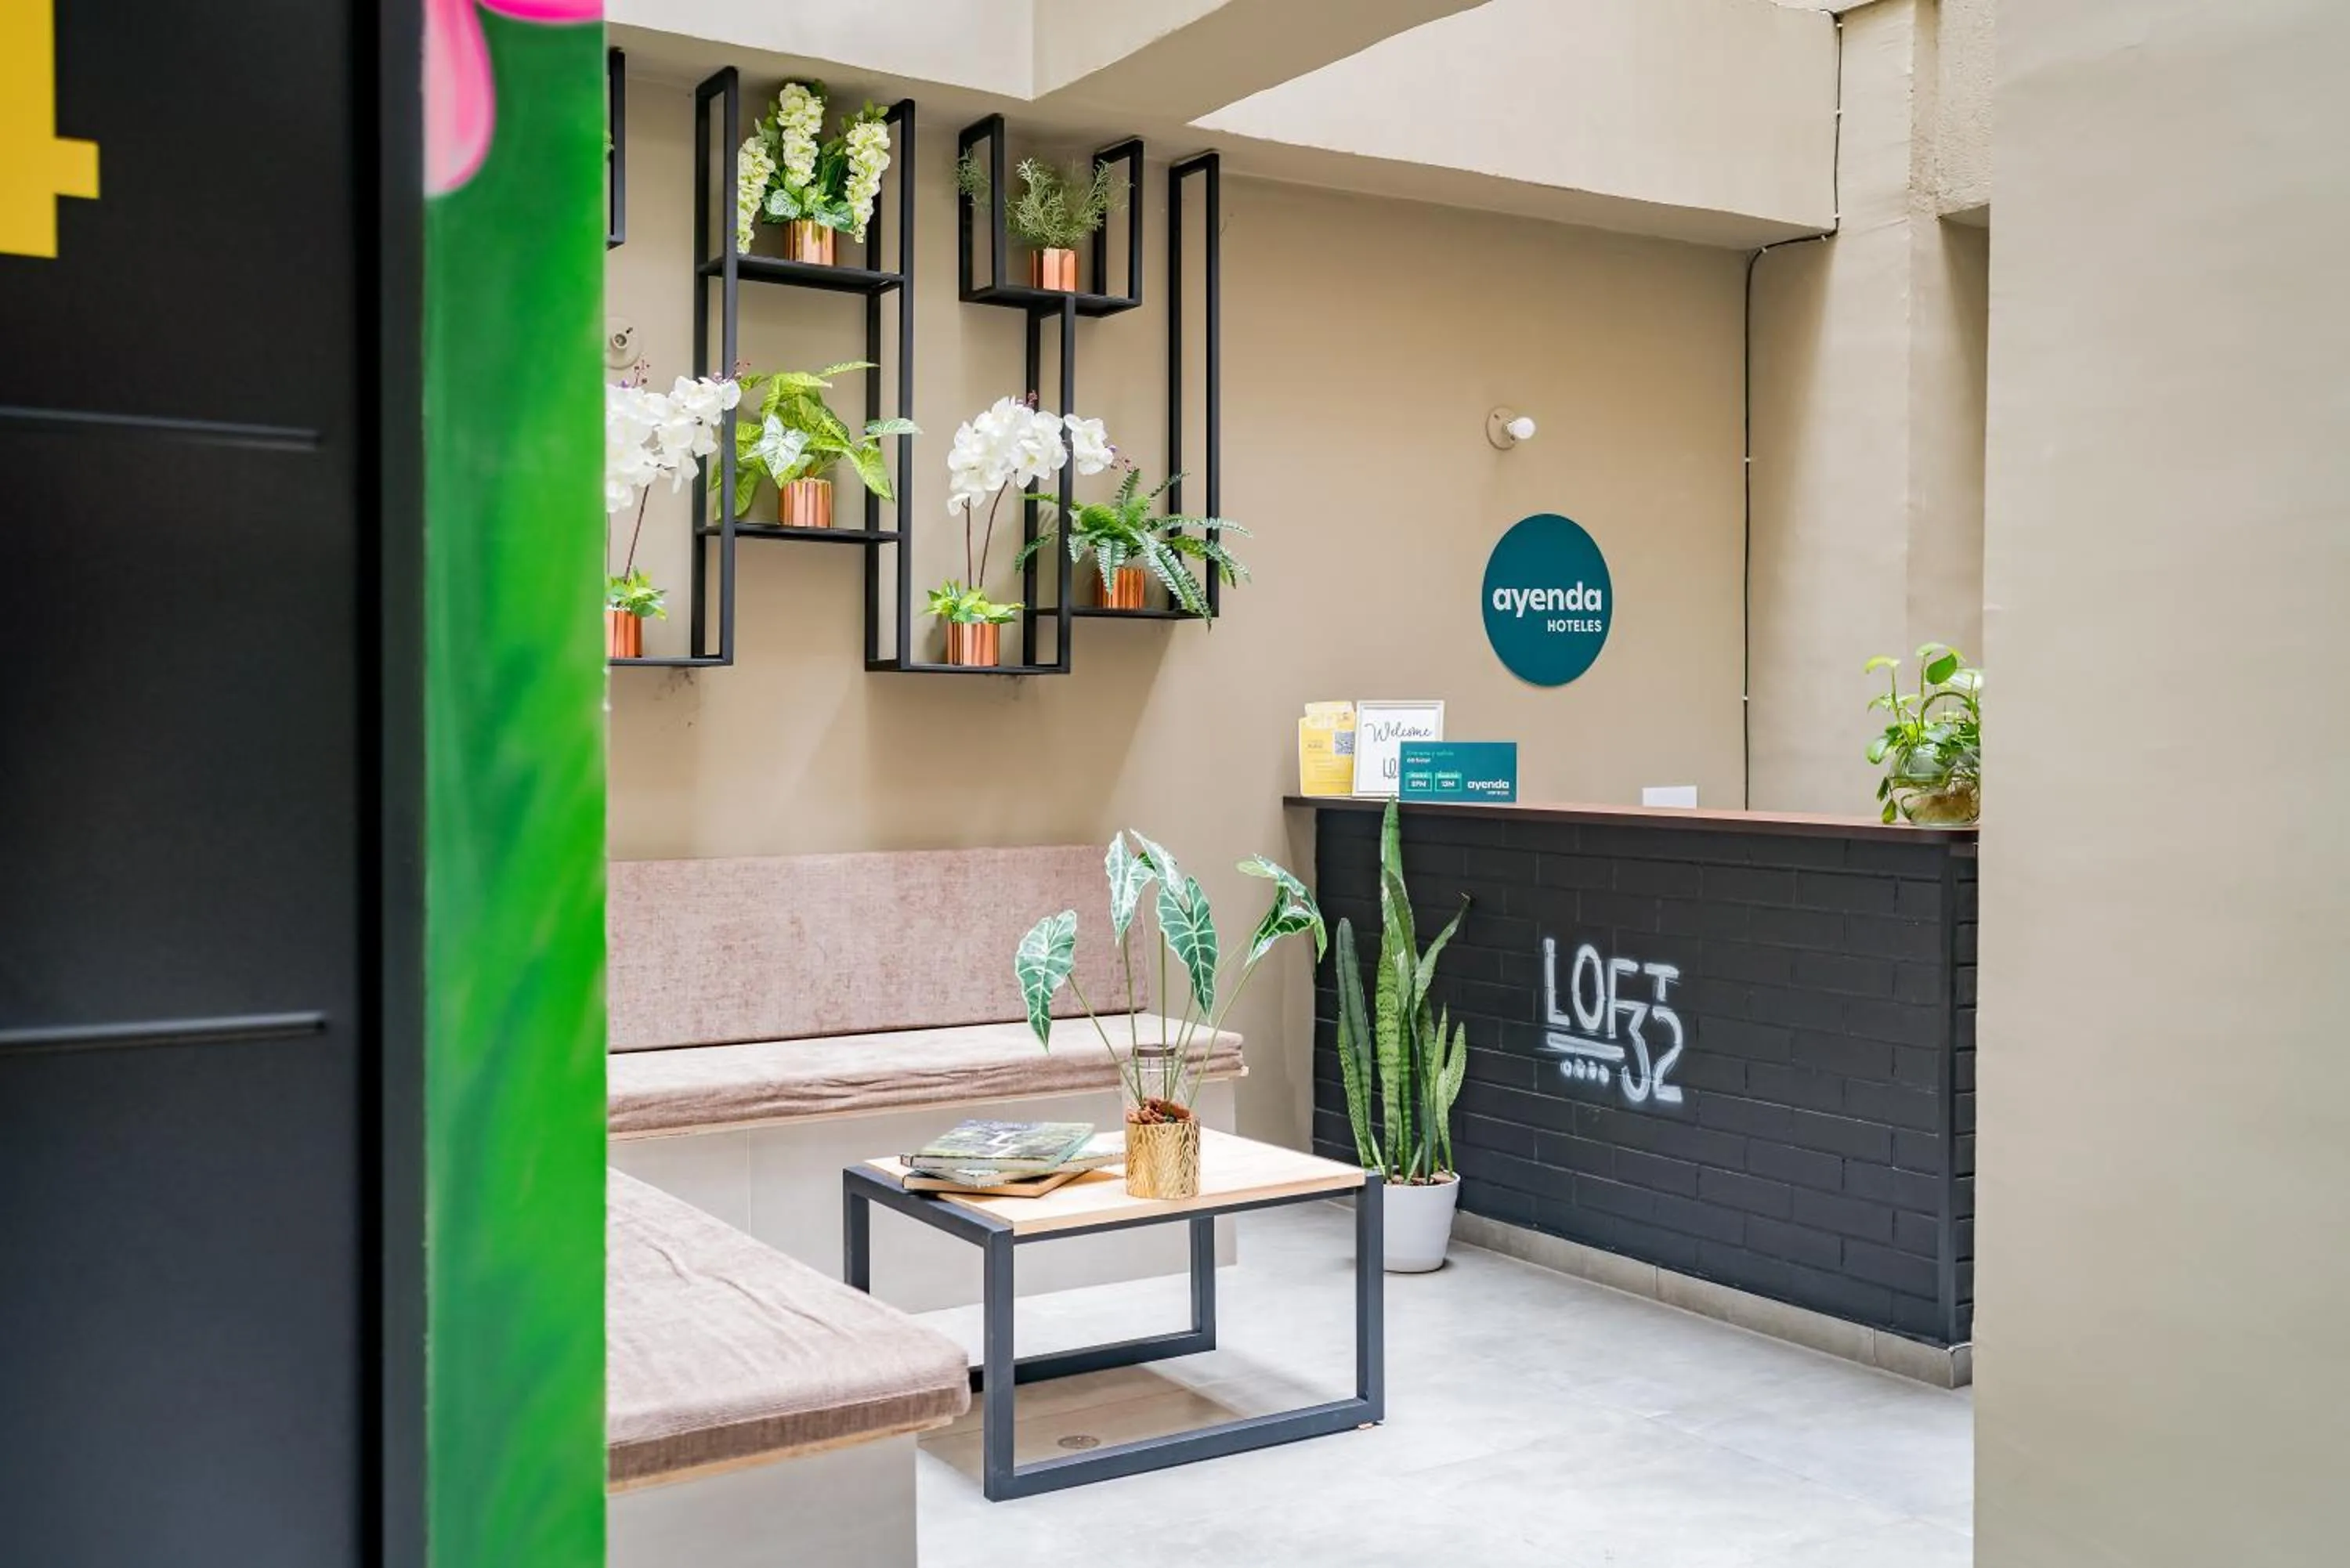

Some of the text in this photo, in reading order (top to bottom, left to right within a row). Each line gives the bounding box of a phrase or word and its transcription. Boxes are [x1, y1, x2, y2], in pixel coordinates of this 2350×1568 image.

[1492, 580, 1603, 618] ayenda
[1546, 620, 1603, 632] HOTELES
[1364, 721, 1433, 742] Welcome
[1467, 779, 1509, 790] ayenda
[1543, 937, 1680, 1039] LOFT
[1620, 1000, 1683, 1103] 32
